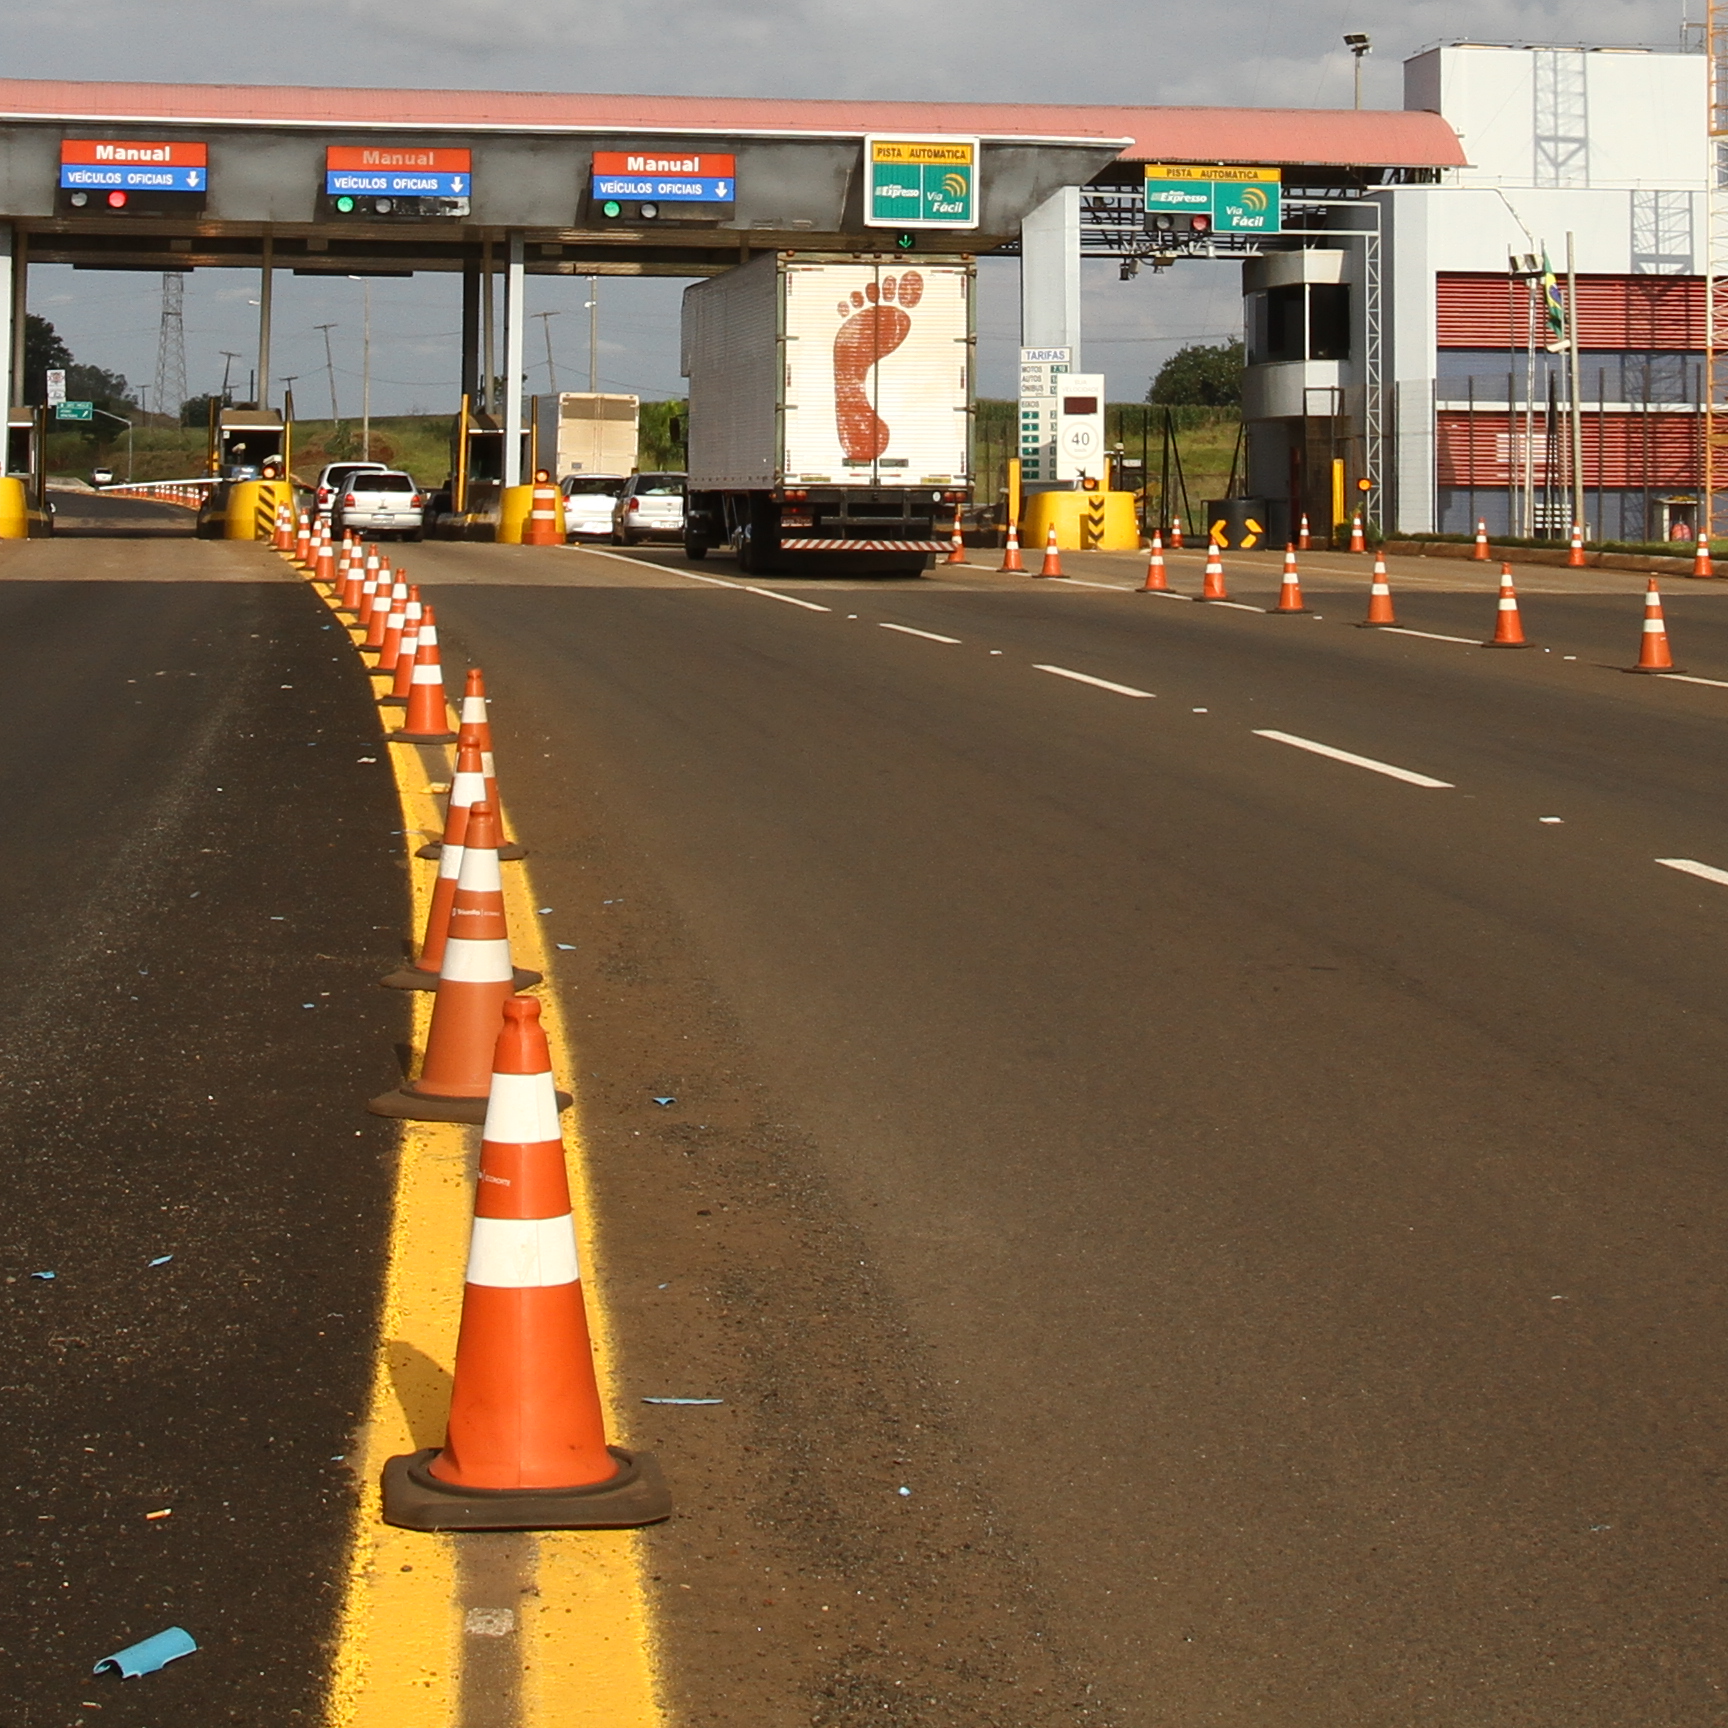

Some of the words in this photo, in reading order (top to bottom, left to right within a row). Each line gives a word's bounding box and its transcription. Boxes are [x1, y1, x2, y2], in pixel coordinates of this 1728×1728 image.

[96, 145, 170, 161] Manual
[362, 150, 434, 166] Manual
[877, 147, 902, 158] PISTA
[627, 156, 700, 172] Manual
[67, 169, 121, 184] VEÍCULOS
[127, 173, 173, 185] OFICIAIS
[1166, 168, 1192, 177] PISTA
[334, 176, 387, 189] VEÍCULOS
[393, 178, 438, 190] OFICIAIS
[599, 180, 653, 194] VEÍCULOS
[658, 183, 703, 195] OFICIAIS
[927, 191, 943, 201] Via
[932, 202, 964, 213] Fácil
[1226, 206, 1243, 215] Via
[1232, 216, 1264, 227] Fácil
[1025, 351, 1065, 360] TARIFAS
[1071, 432, 1090, 446] 40
